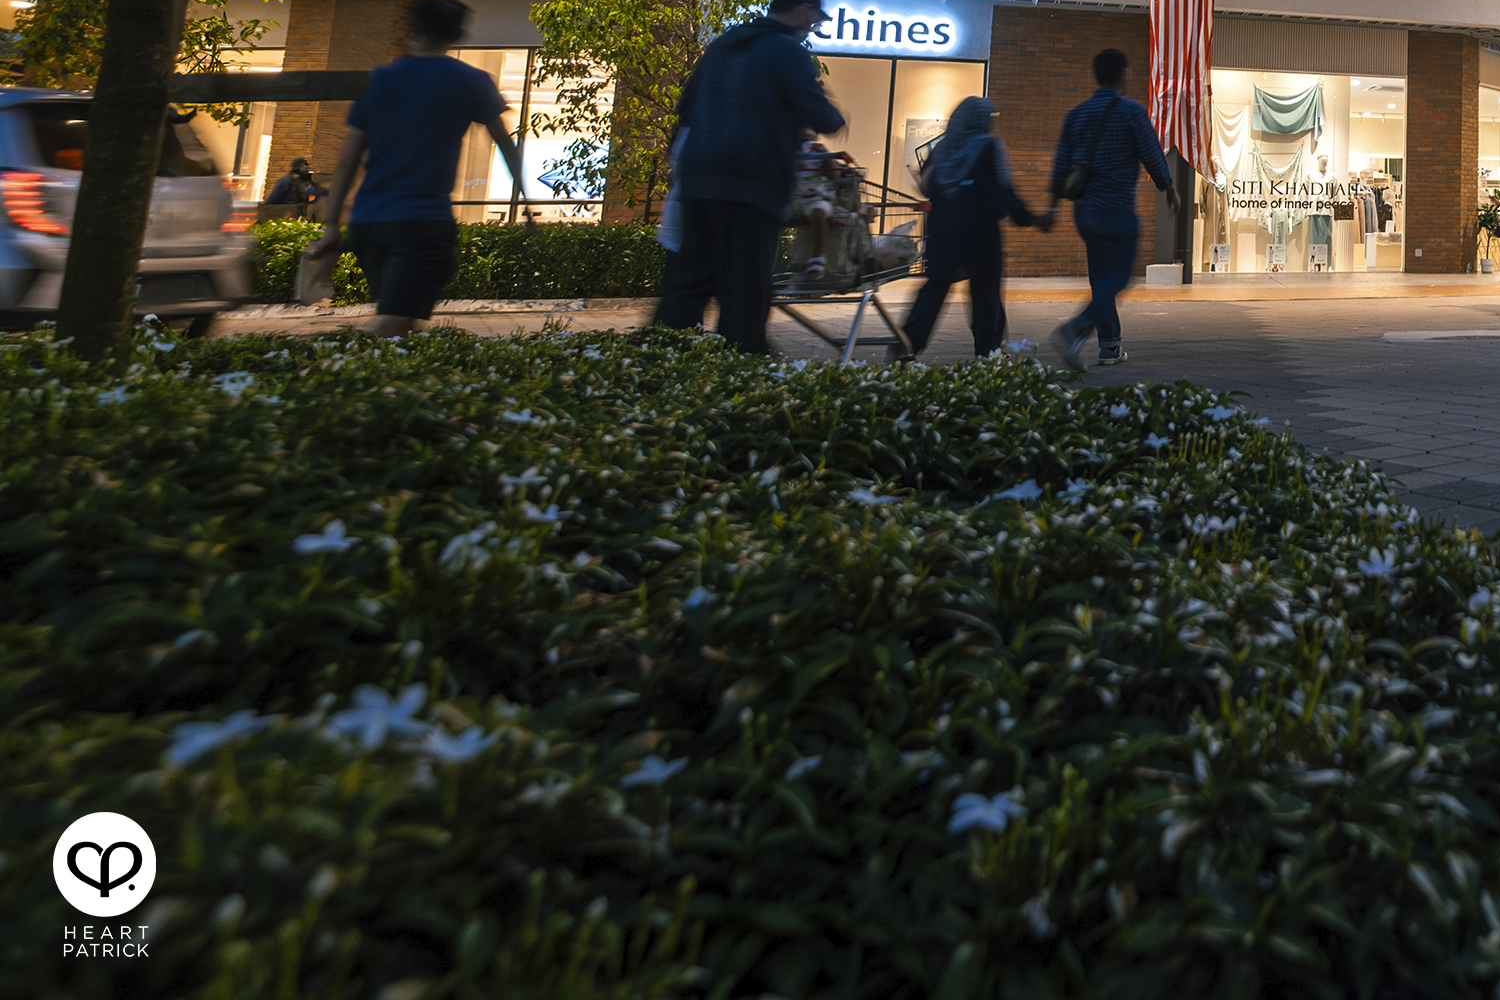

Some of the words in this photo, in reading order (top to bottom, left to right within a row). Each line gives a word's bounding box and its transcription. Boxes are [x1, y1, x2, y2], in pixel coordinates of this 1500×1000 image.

[812, 7, 951, 46] chines
[1231, 179, 1263, 195] SITI
[1269, 179, 1359, 199] KHADIJAH
[1231, 197, 1268, 209] home
[1270, 197, 1283, 209] of
[1284, 197, 1313, 210] inner
